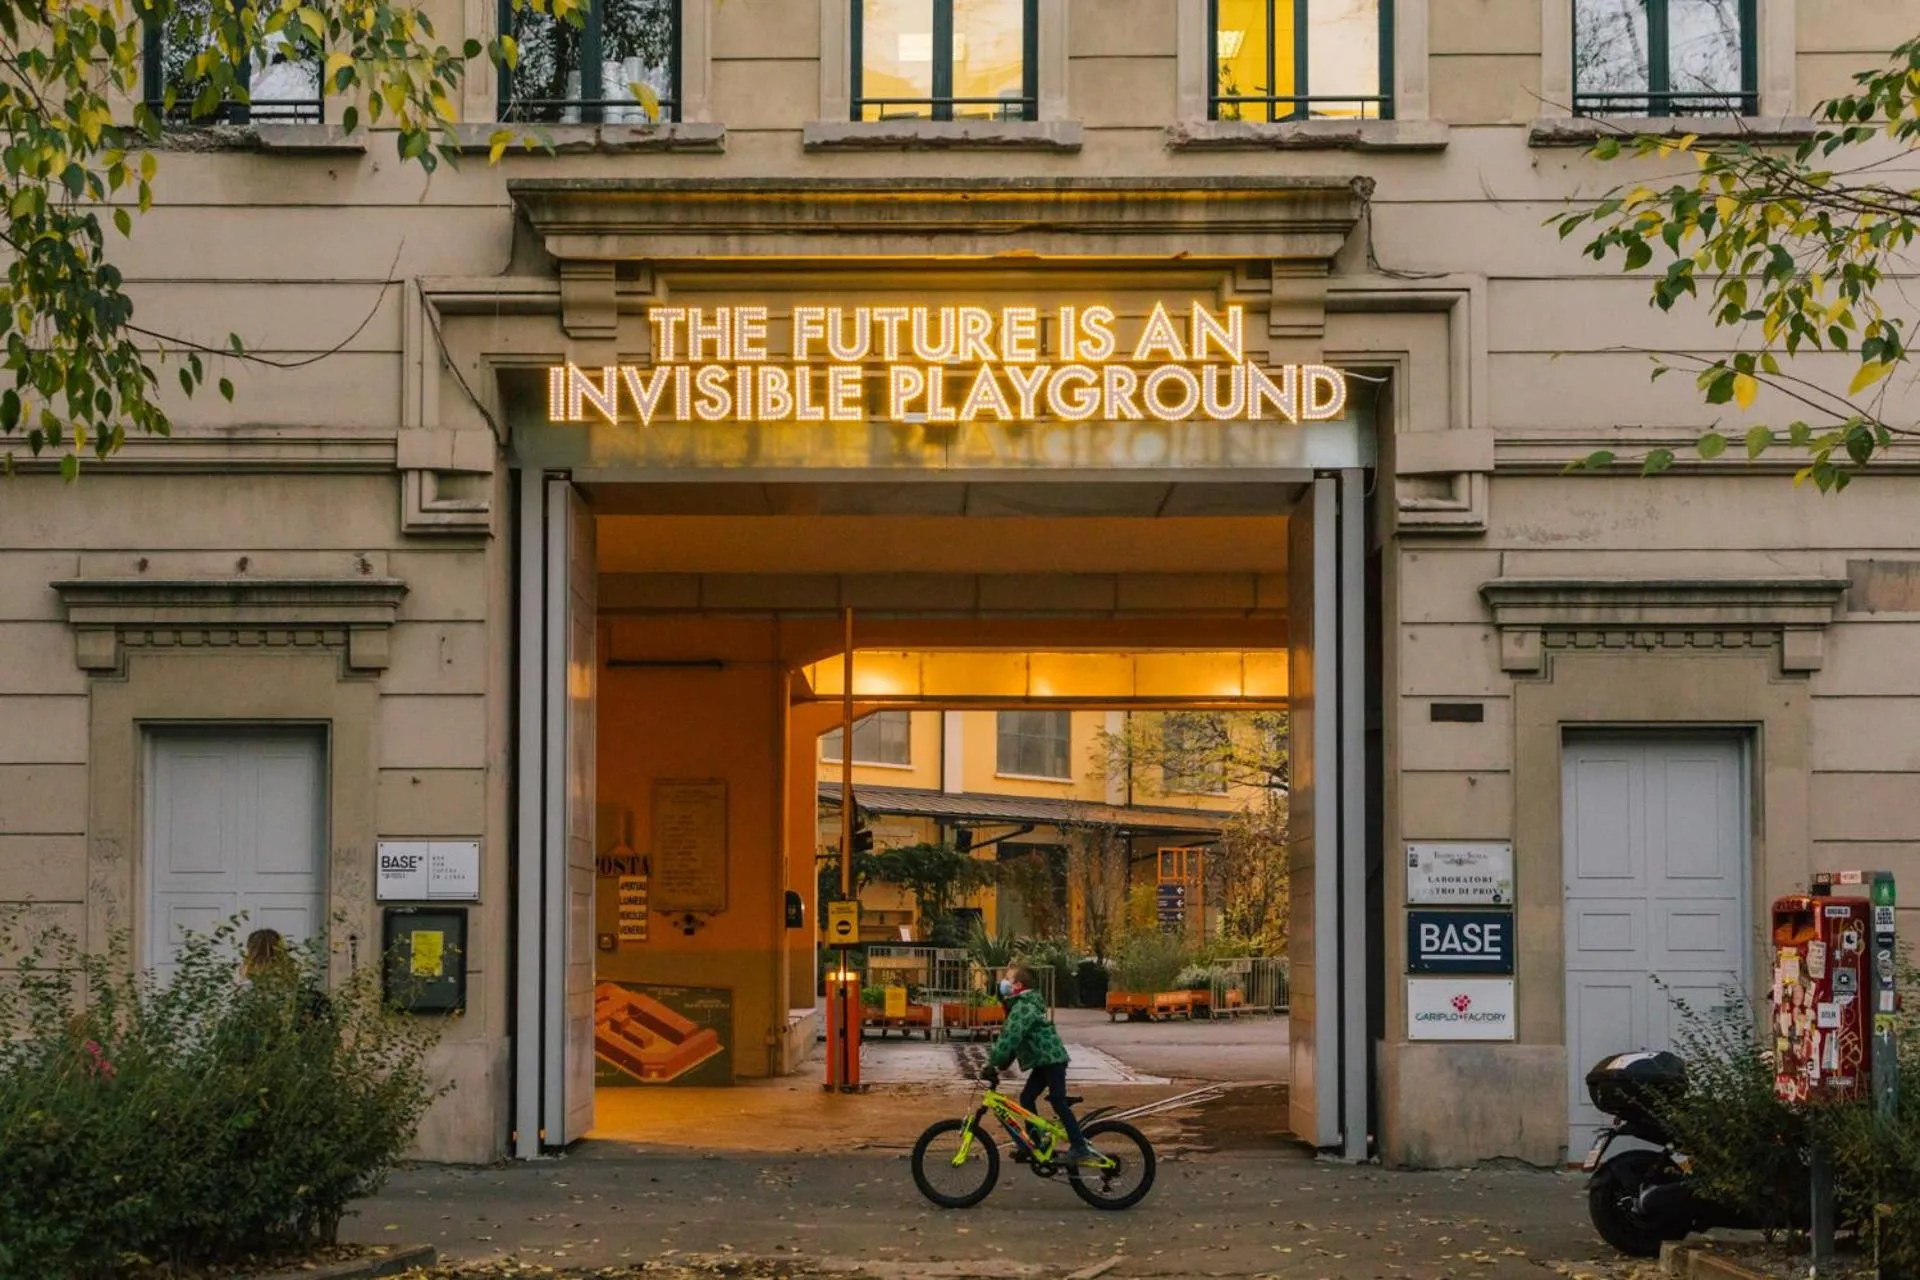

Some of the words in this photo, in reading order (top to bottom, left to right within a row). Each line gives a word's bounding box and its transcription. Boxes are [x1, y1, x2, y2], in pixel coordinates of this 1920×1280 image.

[649, 306, 767, 362] THE
[793, 306, 1037, 362] FUTURE
[1059, 305, 1115, 362] IS
[1132, 300, 1244, 364] AN
[549, 361, 863, 427] INVISIBLE
[889, 360, 1347, 425] PLAYGROUND
[1420, 923, 1501, 953] BASE
